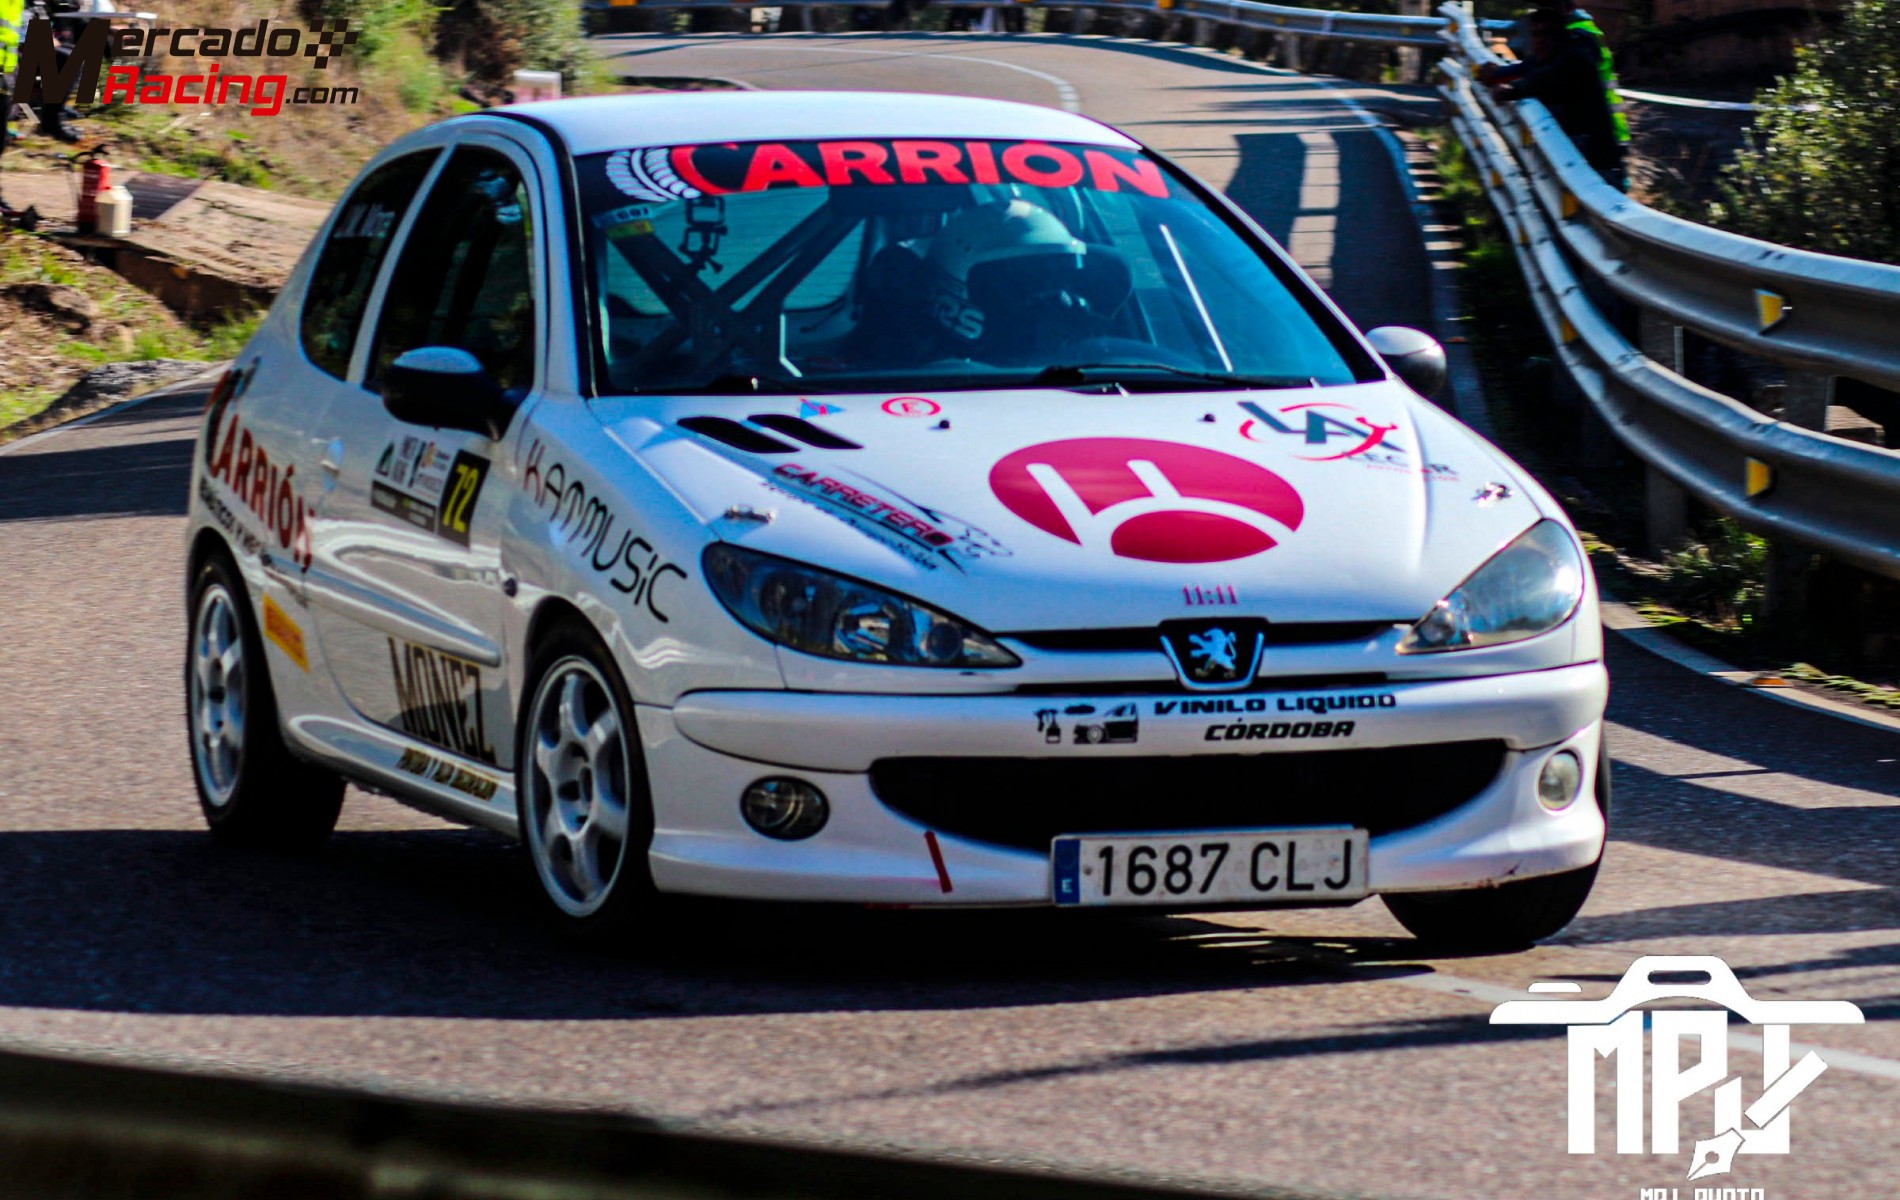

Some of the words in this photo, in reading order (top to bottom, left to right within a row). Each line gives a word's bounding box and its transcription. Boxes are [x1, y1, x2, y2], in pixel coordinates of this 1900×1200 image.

[442, 464, 479, 533] 72
[772, 462, 955, 547] CARRETERO
[1183, 585, 1238, 606] 11:11
[1155, 698, 1266, 716] VINILO
[1277, 694, 1397, 714] LIQUIDO
[1204, 717, 1355, 741] CÓRDOBA
[1099, 842, 1230, 897] 1687
[1249, 838, 1353, 892] CLJ
[1061, 878, 1073, 894] E
